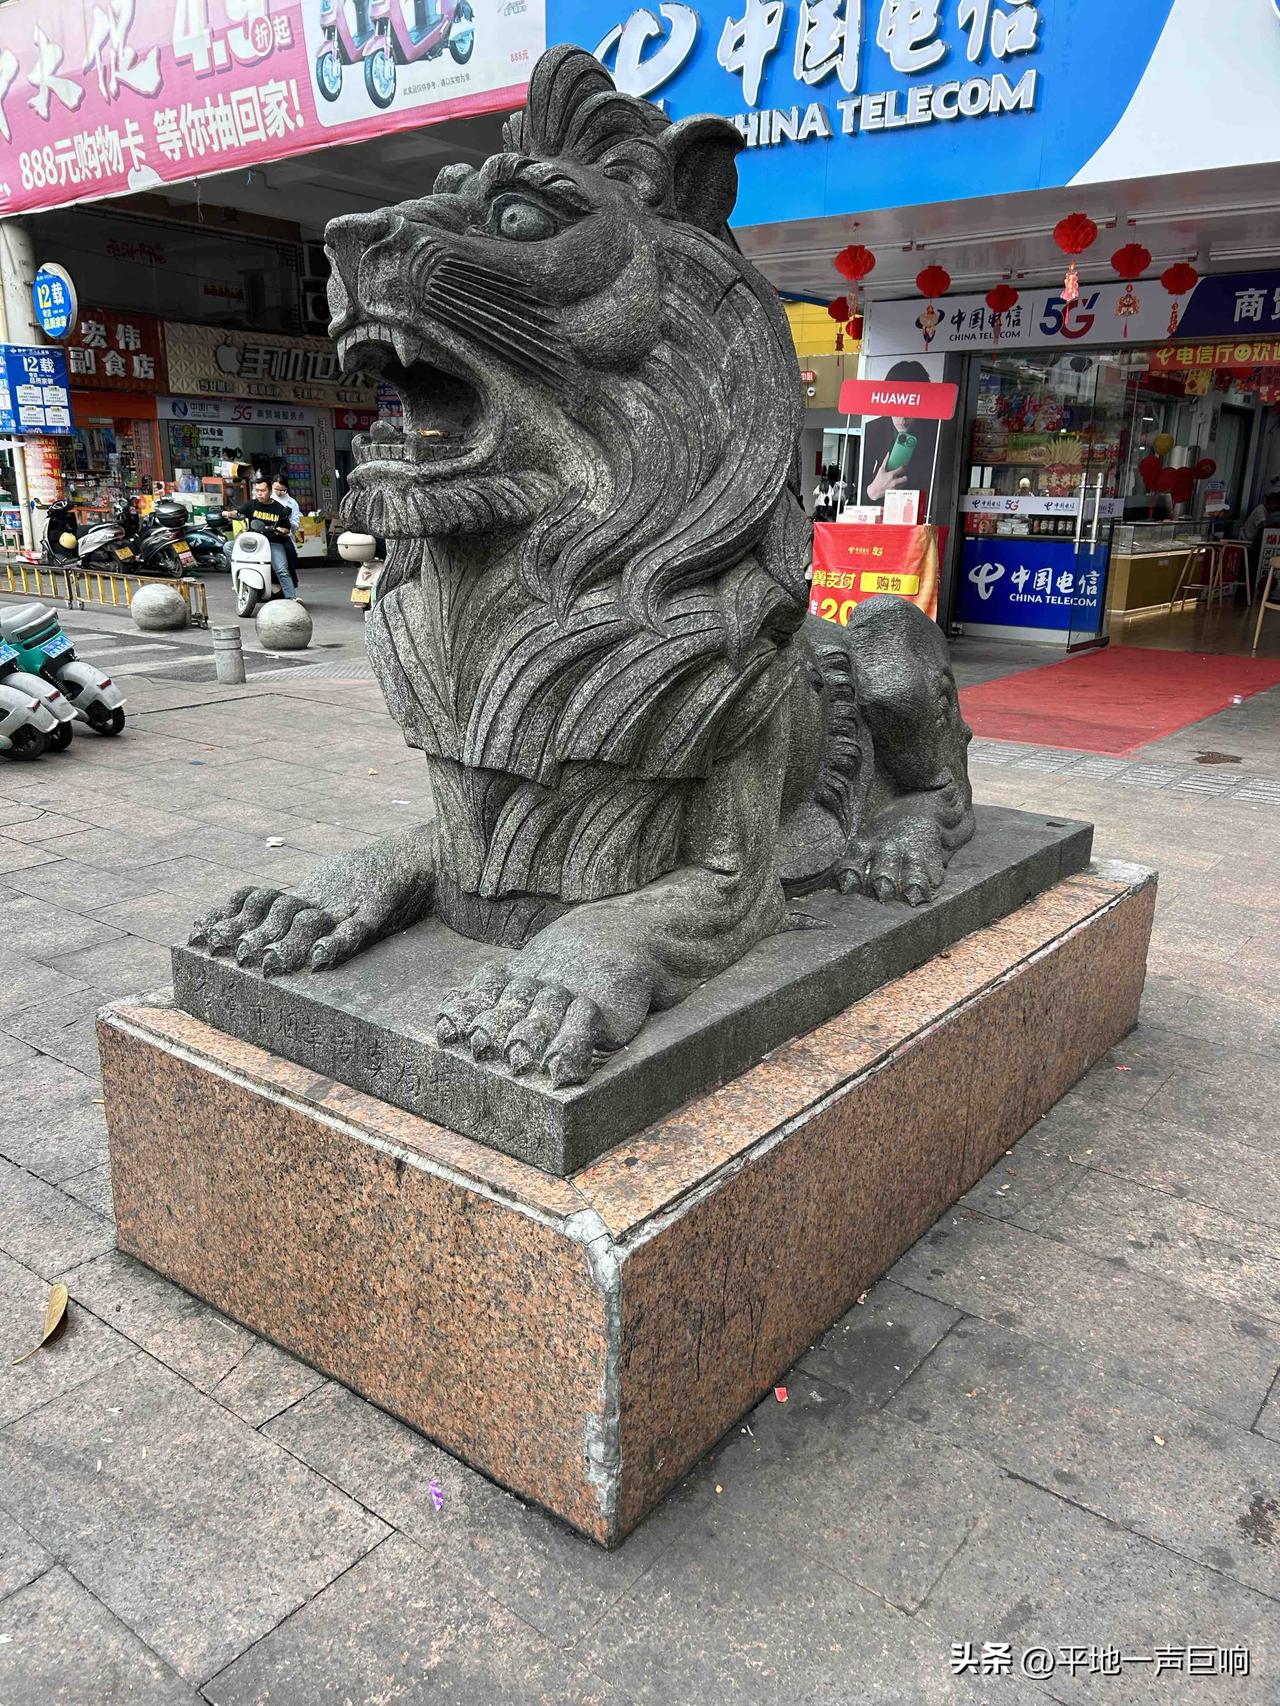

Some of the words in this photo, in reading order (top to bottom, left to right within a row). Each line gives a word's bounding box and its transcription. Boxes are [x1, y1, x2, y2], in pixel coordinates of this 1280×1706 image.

[717, 0, 1039, 106] 中国电信
[838, 69, 1038, 135] TELECOM
[19, 117, 147, 191] 888元购物卡
[950, 304, 1023, 333] 中国电信
[1039, 292, 1100, 339] 5G
[81, 320, 142, 351] 宏伟
[949, 333, 977, 342] CHINA
[979, 330, 1021, 340] TELCOM
[68, 346, 155, 380] 副食店
[1176, 345, 1235, 365] 电信厅
[871, 391, 921, 406] HUAWEI
[231, 405, 252, 421] 5G
[1004, 499, 1020, 511] 5G
[811, 569, 857, 590] 翼支付
[876, 575, 902, 592] 购物
[1011, 564, 1100, 596] 中国电信
[1009, 593, 1043, 603] CHINA
[1045, 595, 1097, 607] TELECOM
